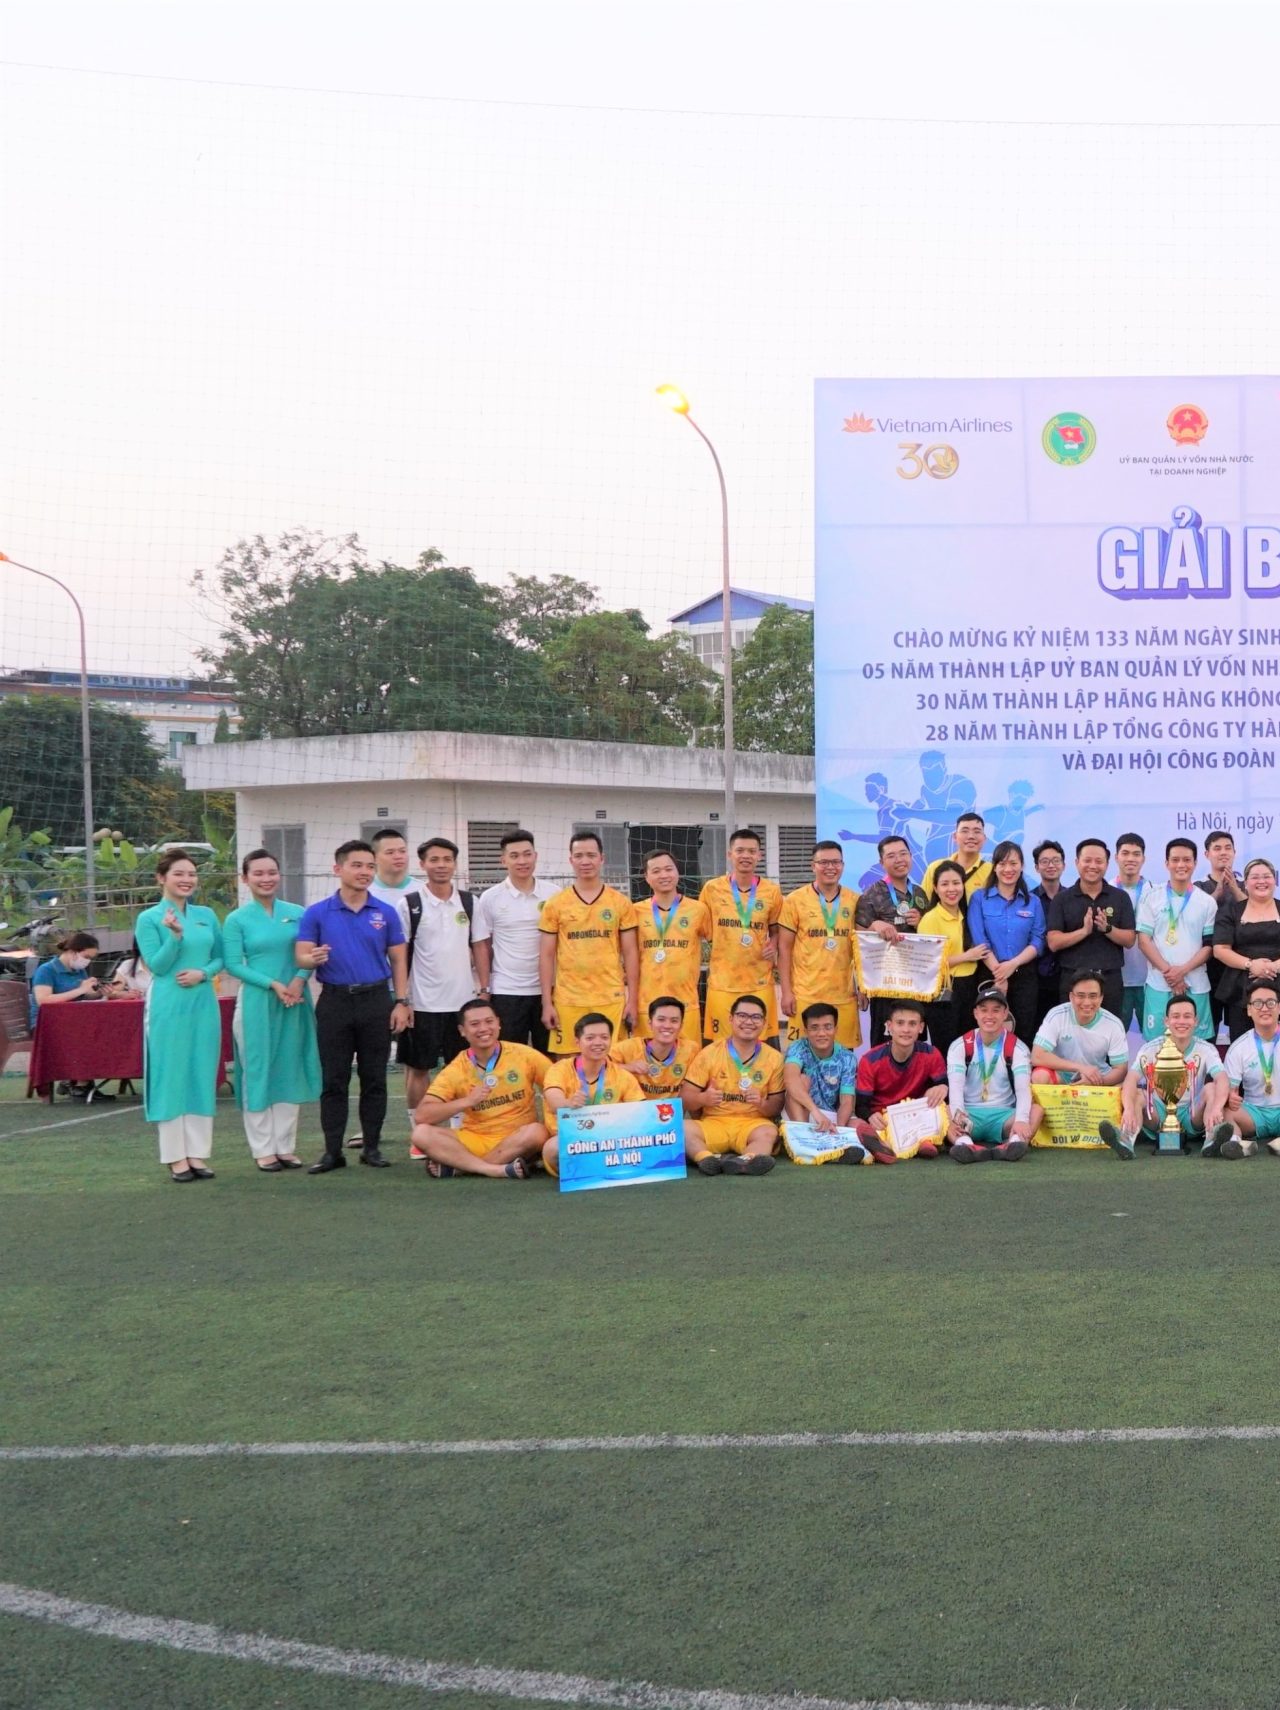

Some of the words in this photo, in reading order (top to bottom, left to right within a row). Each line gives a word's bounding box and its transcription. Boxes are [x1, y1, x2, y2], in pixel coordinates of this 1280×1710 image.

[877, 417, 947, 433] Vietnam
[949, 417, 1013, 433] Airlines
[1132, 456, 1150, 464] BAN
[1164, 467, 1194, 475] DOANH
[1099, 505, 1231, 600] GIẢI
[893, 627, 943, 649] CHÀO
[949, 626, 1008, 649] MỪNG
[1013, 624, 1037, 648] KỶ
[1042, 626, 1090, 652] NIỆM
[1095, 629, 1129, 647] 133
[1135, 625, 1179, 647] NĂM
[1184, 625, 1233, 647] NGÀY
[862, 662, 885, 680] 05
[891, 658, 934, 680] NĂM
[939, 658, 1004, 680] THÀNH
[1010, 657, 1045, 679] LẬP
[1051, 655, 1075, 679] UỶ
[1081, 659, 1118, 678] BAN
[1124, 654, 1178, 680] QUẢN
[1183, 655, 1202, 678] LÝ
[1207, 653, 1247, 677] VỐN
[915, 692, 940, 711] 30
[944, 688, 989, 711] NĂM
[991, 688, 1059, 710] THÀNH
[1063, 687, 1100, 714] LẬP
[1103, 687, 1158, 709] HÃNG
[1162, 687, 1216, 709] HÀNG
[925, 724, 950, 742] 28
[953, 719, 998, 742] NĂM
[1001, 719, 1068, 741] THÀNH
[1073, 719, 1109, 746] LẬP
[1111, 715, 1164, 740] TỔNG
[1167, 717, 1219, 739] CÔNG
[1222, 720, 1248, 739] TY
[1061, 749, 1088, 771] VÀ
[1089, 752, 1124, 775] ĐẠI
[1128, 748, 1163, 775] HỘI
[1166, 748, 1218, 770] CÔNG
[1221, 747, 1276, 769] ĐOÀN
[1176, 811, 1198, 830] Hà
[1236, 811, 1275, 834] ngày
[712, 1019, 720, 1033] 8
[1147, 1014, 1154, 1029] 8
[567, 1140, 599, 1155] CÔNG
[600, 1139, 616, 1151] AN
[618, 1134, 654, 1149] THÀNH
[655, 1129, 677, 1145] PHỐ
[605, 1154, 620, 1167] HÀ
[622, 1151, 642, 1167] NỘI
